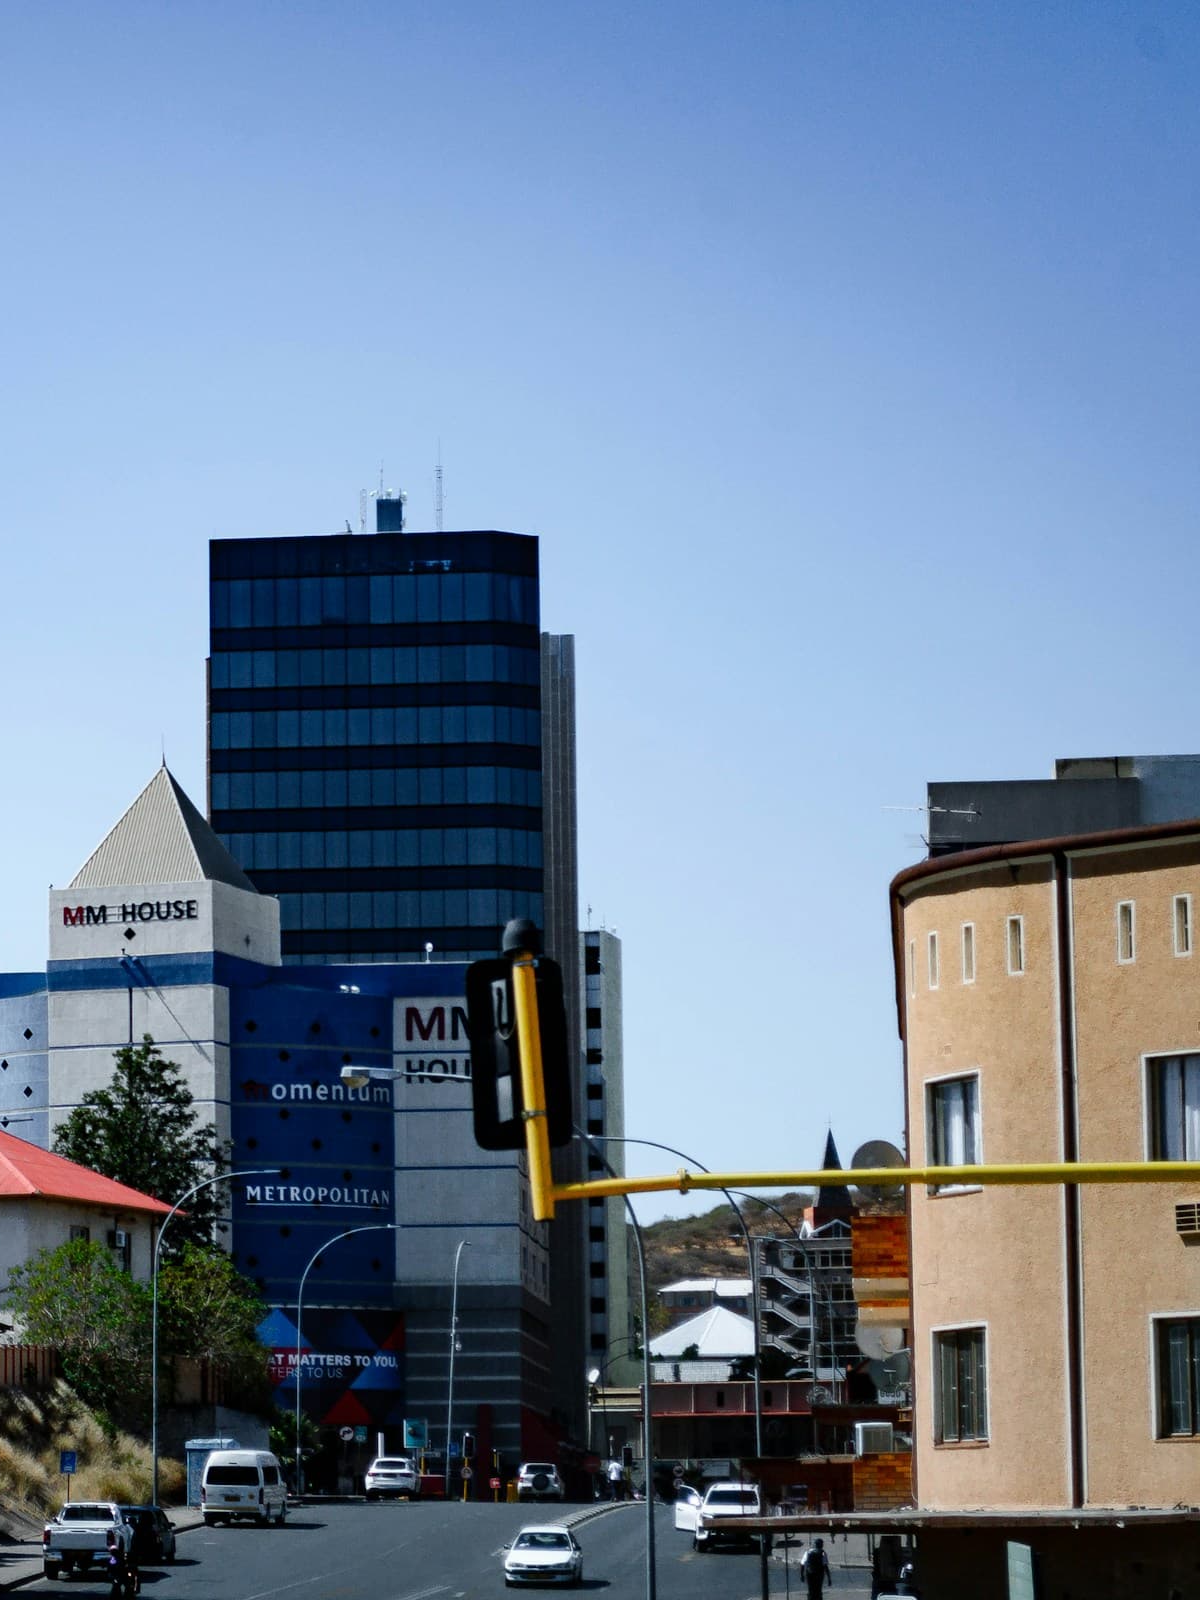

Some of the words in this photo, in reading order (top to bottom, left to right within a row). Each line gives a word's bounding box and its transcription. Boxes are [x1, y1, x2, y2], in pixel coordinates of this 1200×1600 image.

[63, 905, 107, 925] MM
[121, 900, 197, 922] HOUSE
[406, 1059, 471, 1083] HOU
[241, 1081, 390, 1104] momentum
[246, 1185, 390, 1204] METROPOLITAN
[287, 1353, 352, 1367] MATTERS
[353, 1354, 371, 1367] TO
[373, 1355, 399, 1369] YOU,
[307, 1367, 324, 1378] TO
[327, 1367, 344, 1378] US
